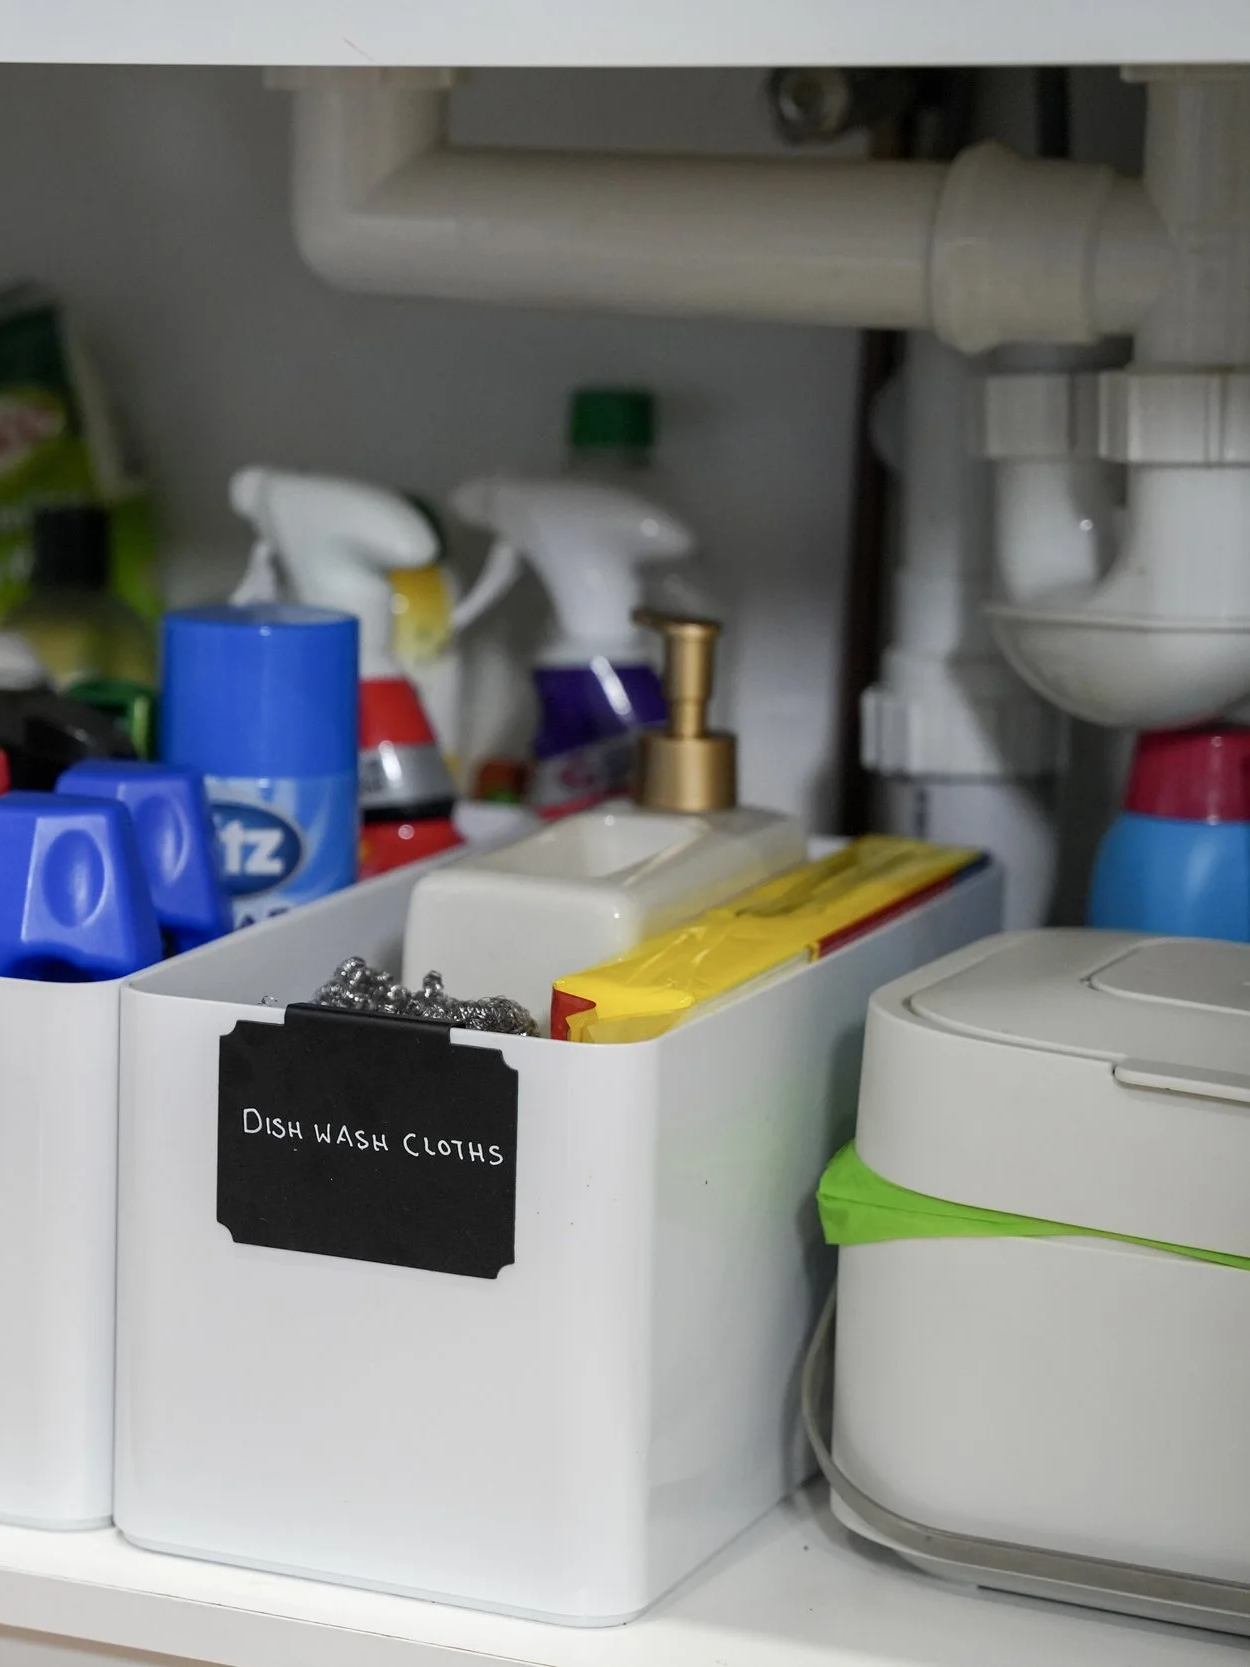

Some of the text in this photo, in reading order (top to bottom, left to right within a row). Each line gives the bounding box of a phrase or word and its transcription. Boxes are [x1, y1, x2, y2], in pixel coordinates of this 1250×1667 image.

[213, 813, 285, 876] tz
[243, 1108, 504, 1166] DISH WASH CLOTHS
